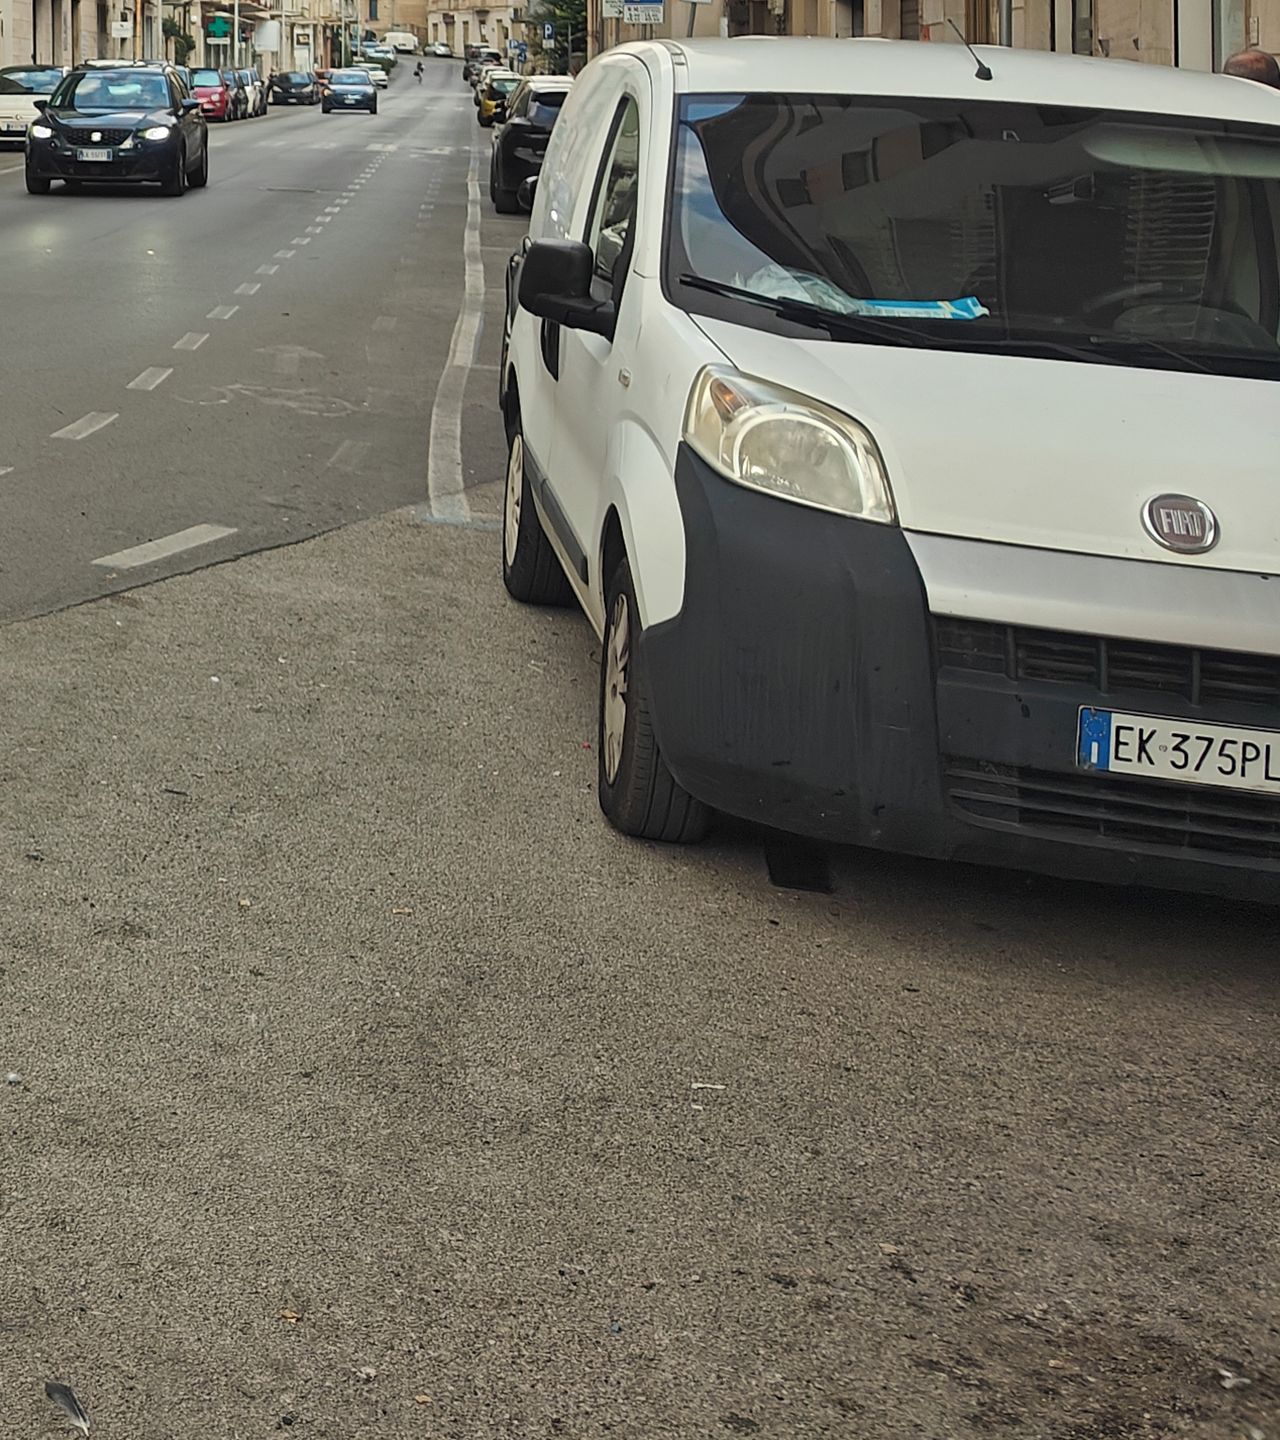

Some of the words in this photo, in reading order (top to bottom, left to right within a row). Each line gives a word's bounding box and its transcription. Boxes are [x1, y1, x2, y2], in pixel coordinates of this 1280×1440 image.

[1159, 508, 1203, 537] FIAT
[1114, 725, 1157, 766] EK
[1169, 733, 1280, 782] 375PL
